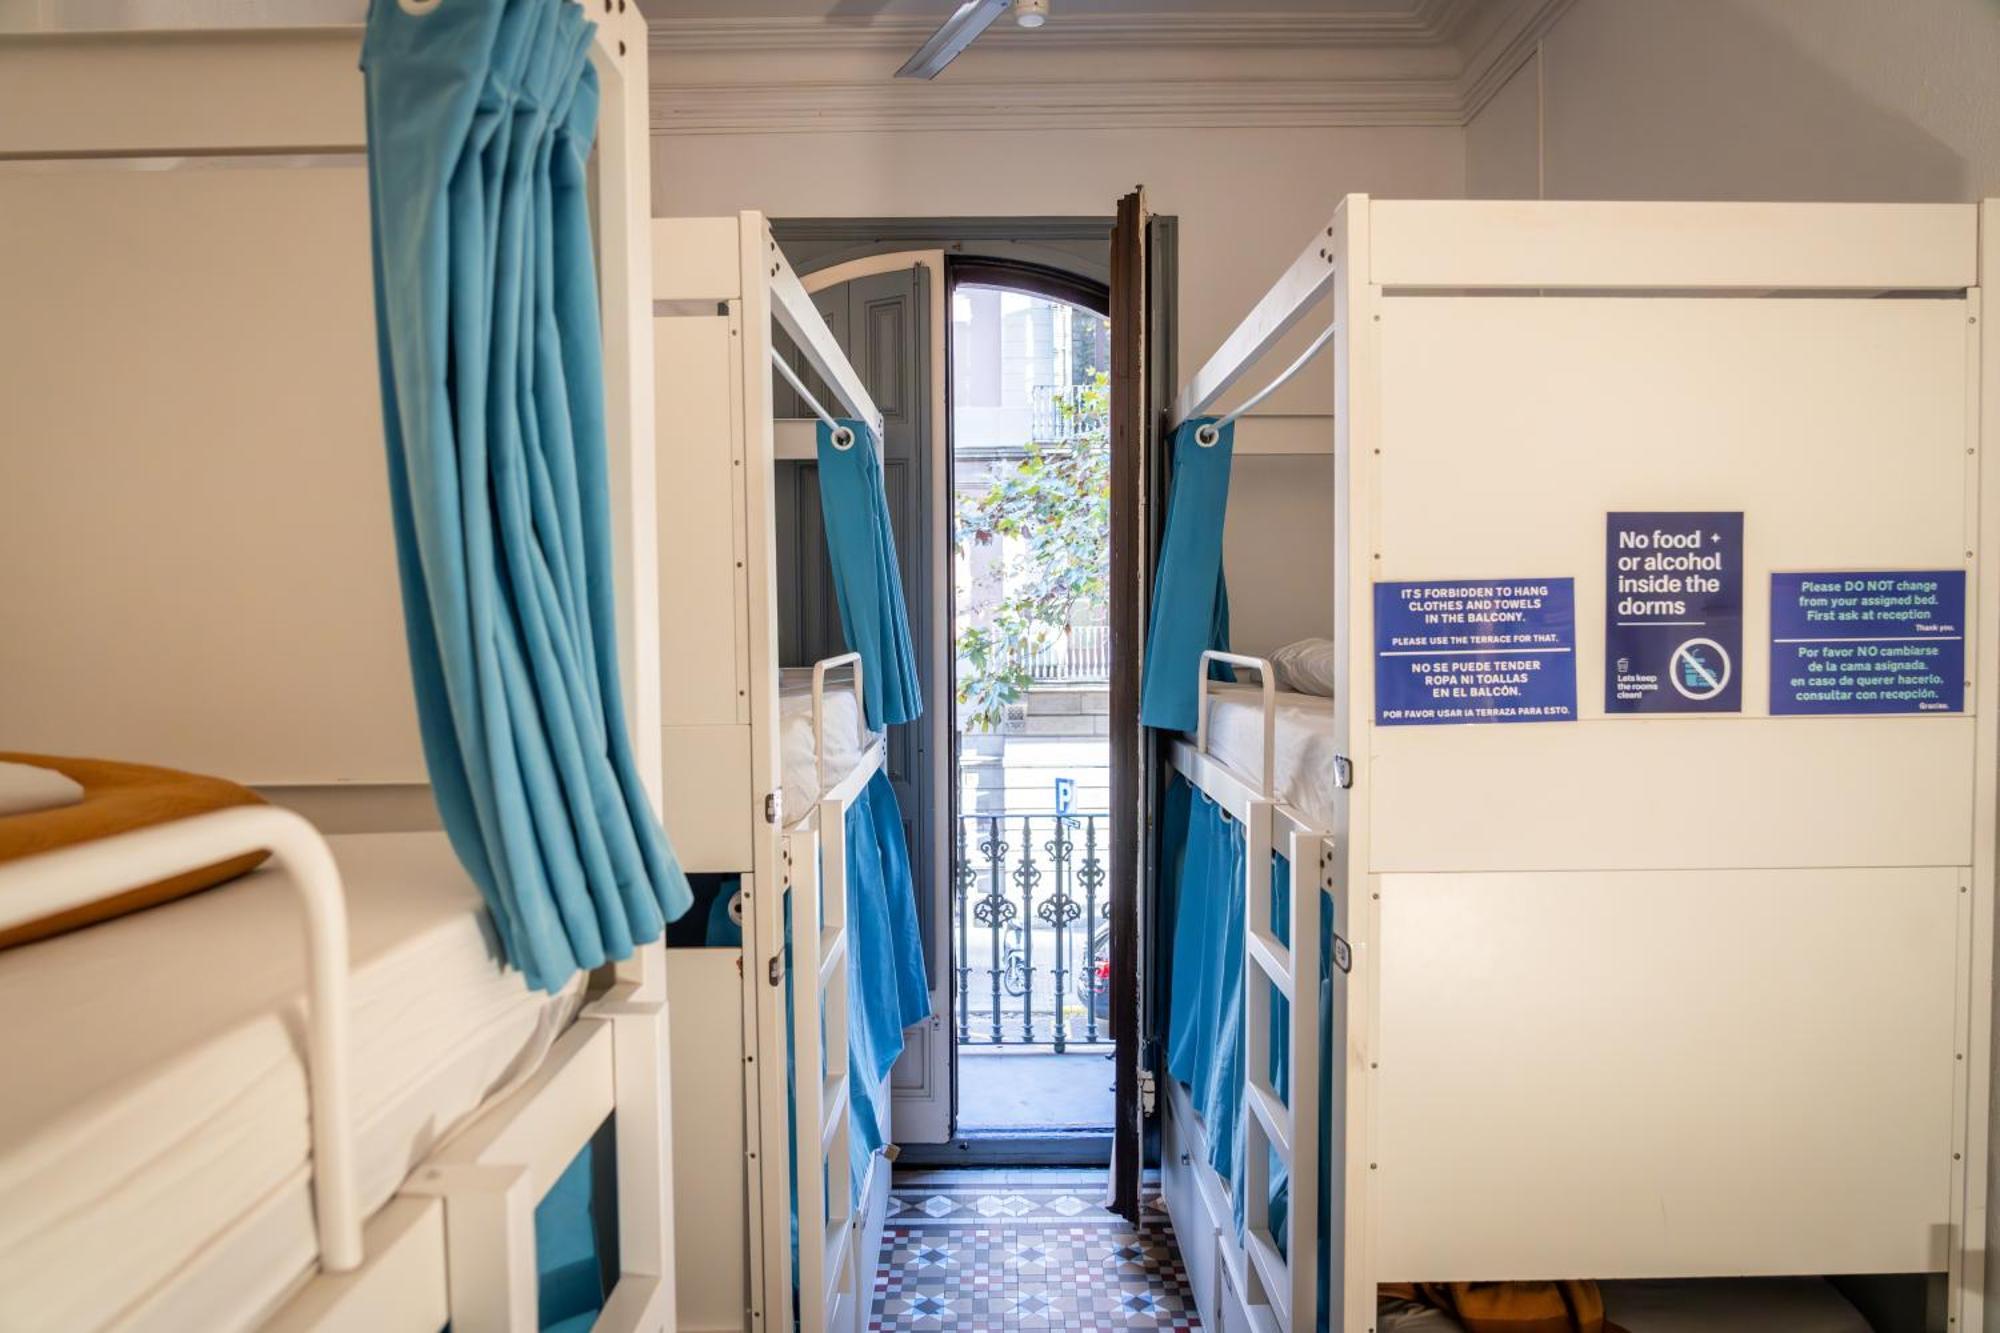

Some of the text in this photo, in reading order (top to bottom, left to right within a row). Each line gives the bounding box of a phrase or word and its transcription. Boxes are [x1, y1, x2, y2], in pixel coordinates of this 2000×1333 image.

[1619, 530, 1701, 549] No food
[1618, 553, 1722, 571] or alcohol
[1618, 575, 1720, 593] inside the
[1801, 580, 1937, 593] Please DO NOT change
[1424, 587, 1494, 598] FORBIDDEN
[1496, 587, 1511, 597] TO
[1514, 586, 1548, 596] HANG
[1409, 600, 1541, 611] CLOTHES AND TOWELS
[1618, 597, 1686, 615] dorms
[1799, 595, 1939, 610] from your assigned bed.
[1425, 612, 1526, 624] IN THE BALCONY.
[1807, 612, 1836, 621] First
[1838, 611, 1859, 620] ask
[1877, 609, 1931, 621] reception
[1392, 637, 1427, 646] PLEASE
[1470, 635, 1511, 644] TERRACE
[1533, 634, 1559, 642] THAT.
[1798, 646, 1939, 657] Por favor NO cambiarse
[1411, 661, 1540, 673] NO SE PUEDE TENDER
[1808, 660, 1928, 673] de la cama asignada.
[1425, 673, 1528, 686] ROPA NI TOALLAS
[1636, 675, 1657, 683] keep
[1791, 677, 1805, 686] en
[1808, 676, 1836, 686] caso
[1839, 676, 1854, 685] de
[1857, 675, 1895, 688] querer
[1433, 686, 1521, 698] EN EL BALCÓN.
[1795, 688, 1939, 701] consultar con recepción.
[1383, 711, 1402, 719] POR
[1404, 710, 1435, 718] FAVOR
[1437, 709, 1462, 718] USAR
[1476, 708, 1516, 716] TERRAZA
[1518, 707, 1542, 715] PARA
[1544, 706, 1570, 715] ESTO.
[1059, 782, 1071, 811] P
